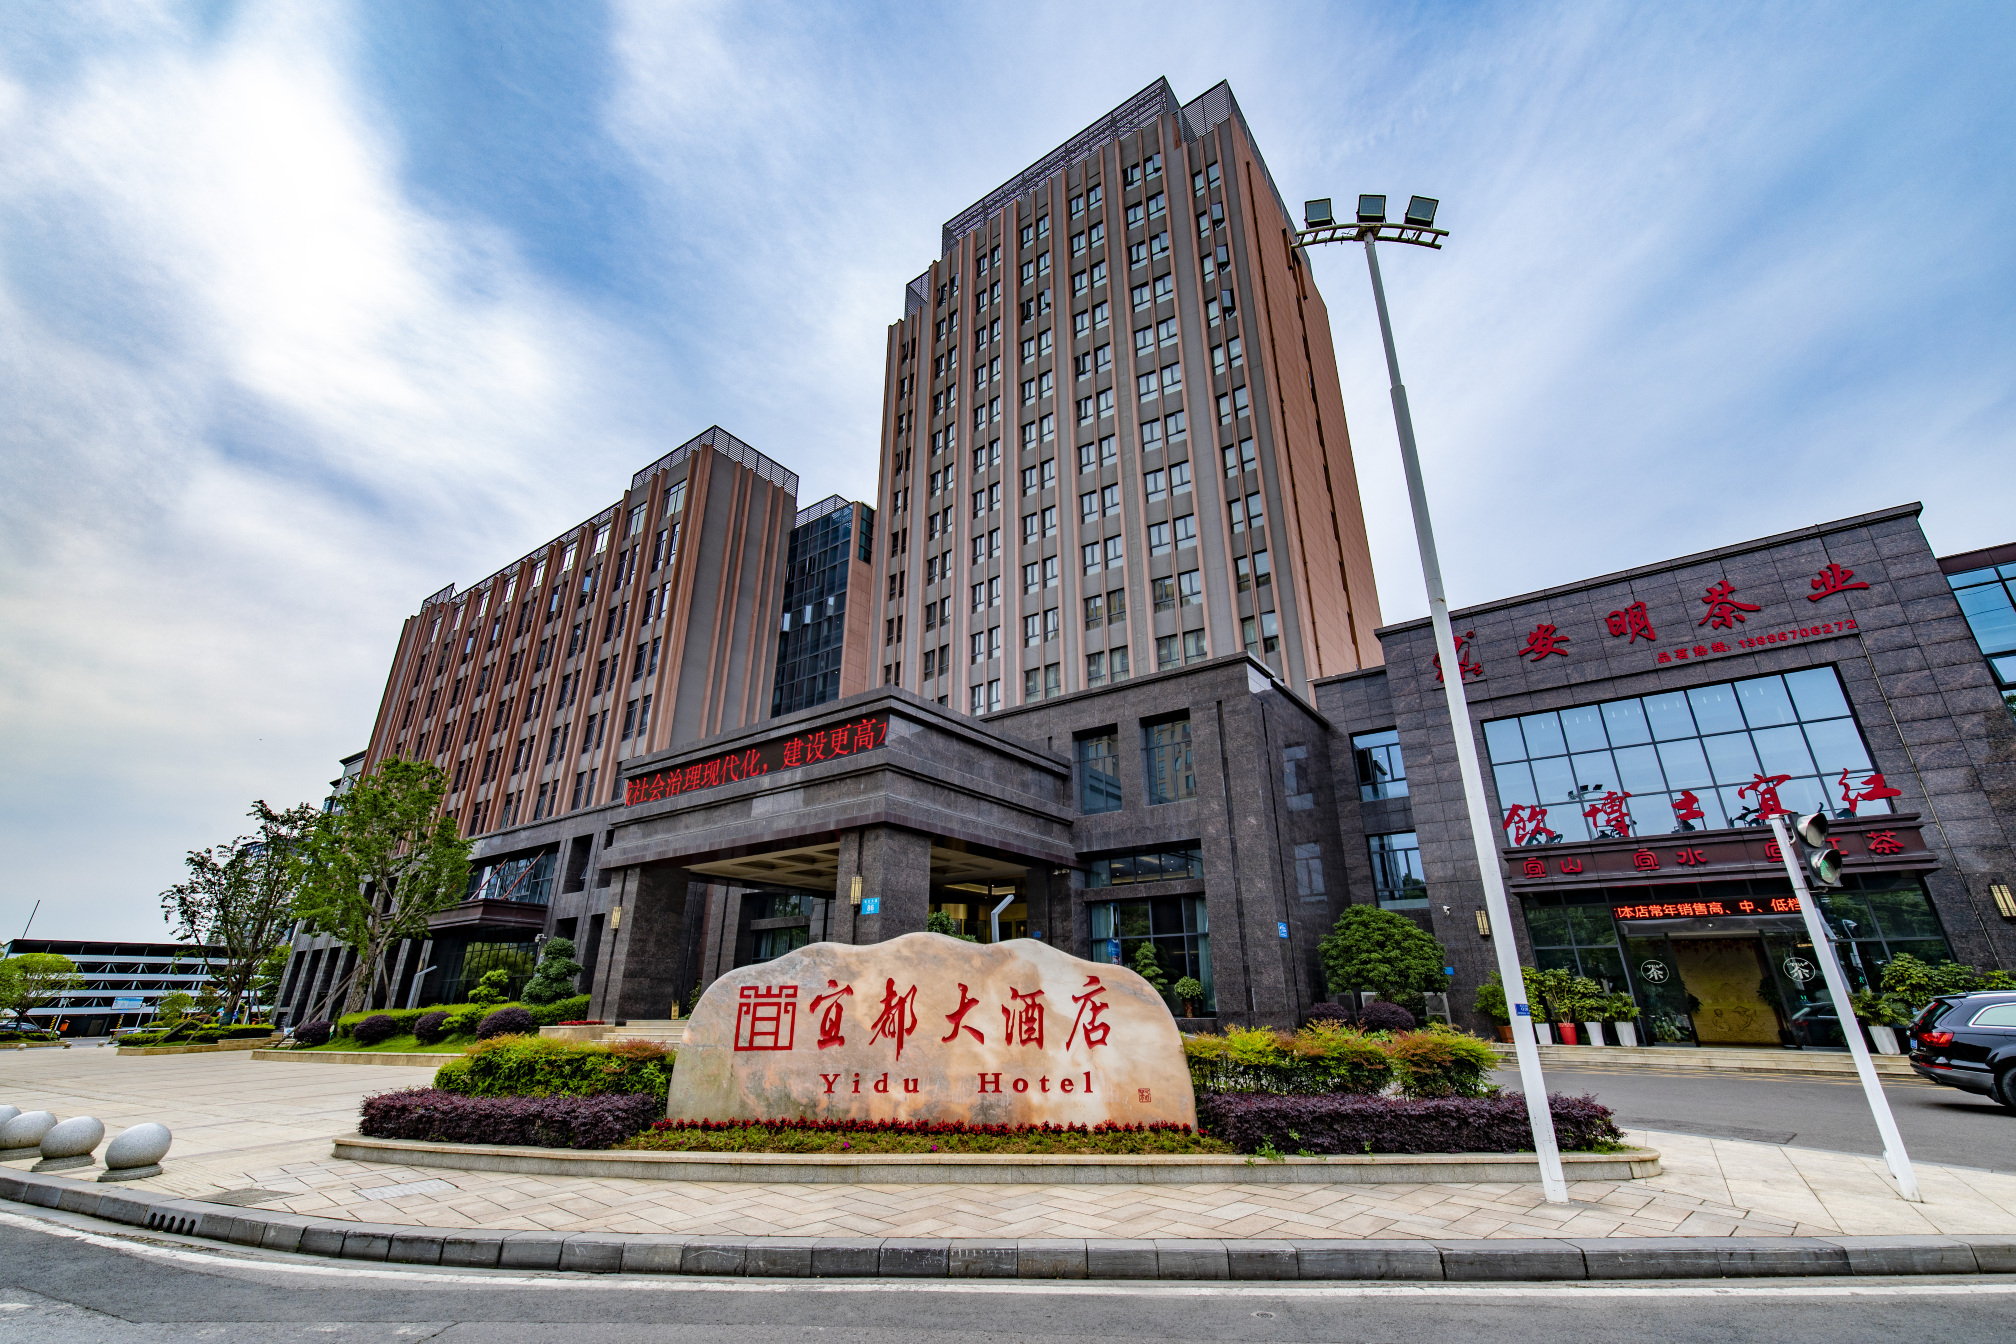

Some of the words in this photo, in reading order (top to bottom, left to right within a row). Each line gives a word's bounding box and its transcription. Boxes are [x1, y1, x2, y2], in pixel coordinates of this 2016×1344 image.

[1518, 563, 1870, 662] 安明茶业
[1738, 618, 1858, 650] 13886706272
[809, 975, 1110, 1062] 宜都大酒店
[819, 1072, 921, 1095] Yidu
[977, 1071, 1094, 1095] Hotel
